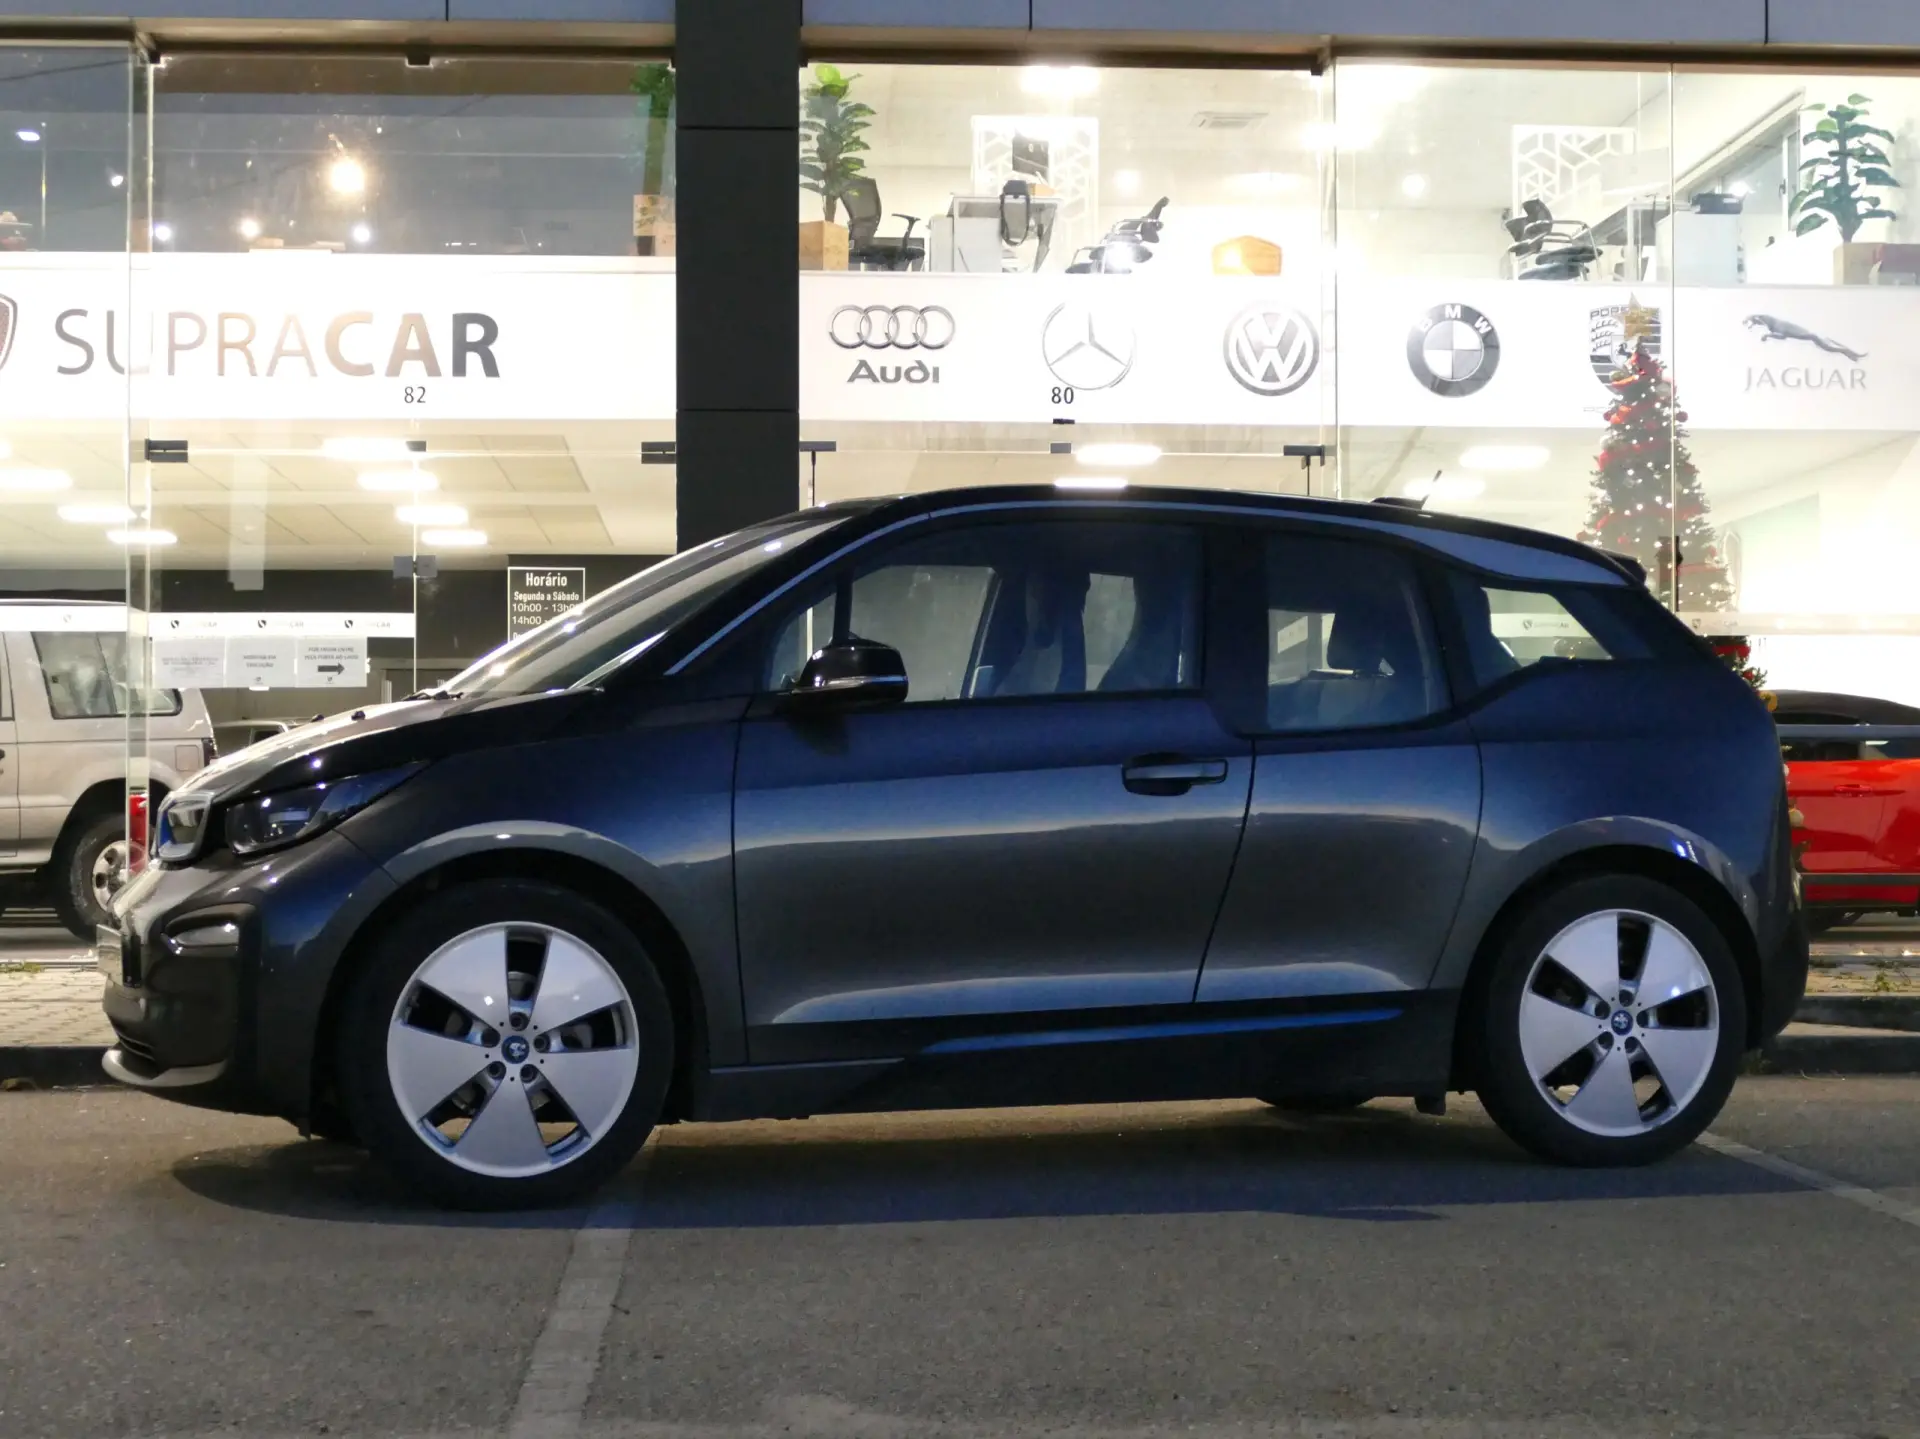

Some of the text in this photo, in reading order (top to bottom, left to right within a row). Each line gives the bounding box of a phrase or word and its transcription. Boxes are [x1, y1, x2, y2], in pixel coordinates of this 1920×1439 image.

[1419, 304, 1493, 334] BMW
[55, 309, 500, 378] SUPRACAR
[847, 359, 940, 383] Audi
[1744, 367, 1867, 392] JAGUAR
[404, 386, 426, 404] 82
[1051, 386, 1074, 404] 80
[526, 572, 568, 586] Horário
[514, 591, 545, 602] Segunda
[553, 591, 580, 600] Sábado
[512, 603, 542, 613] 10h00
[512, 616, 542, 625] 14h00
